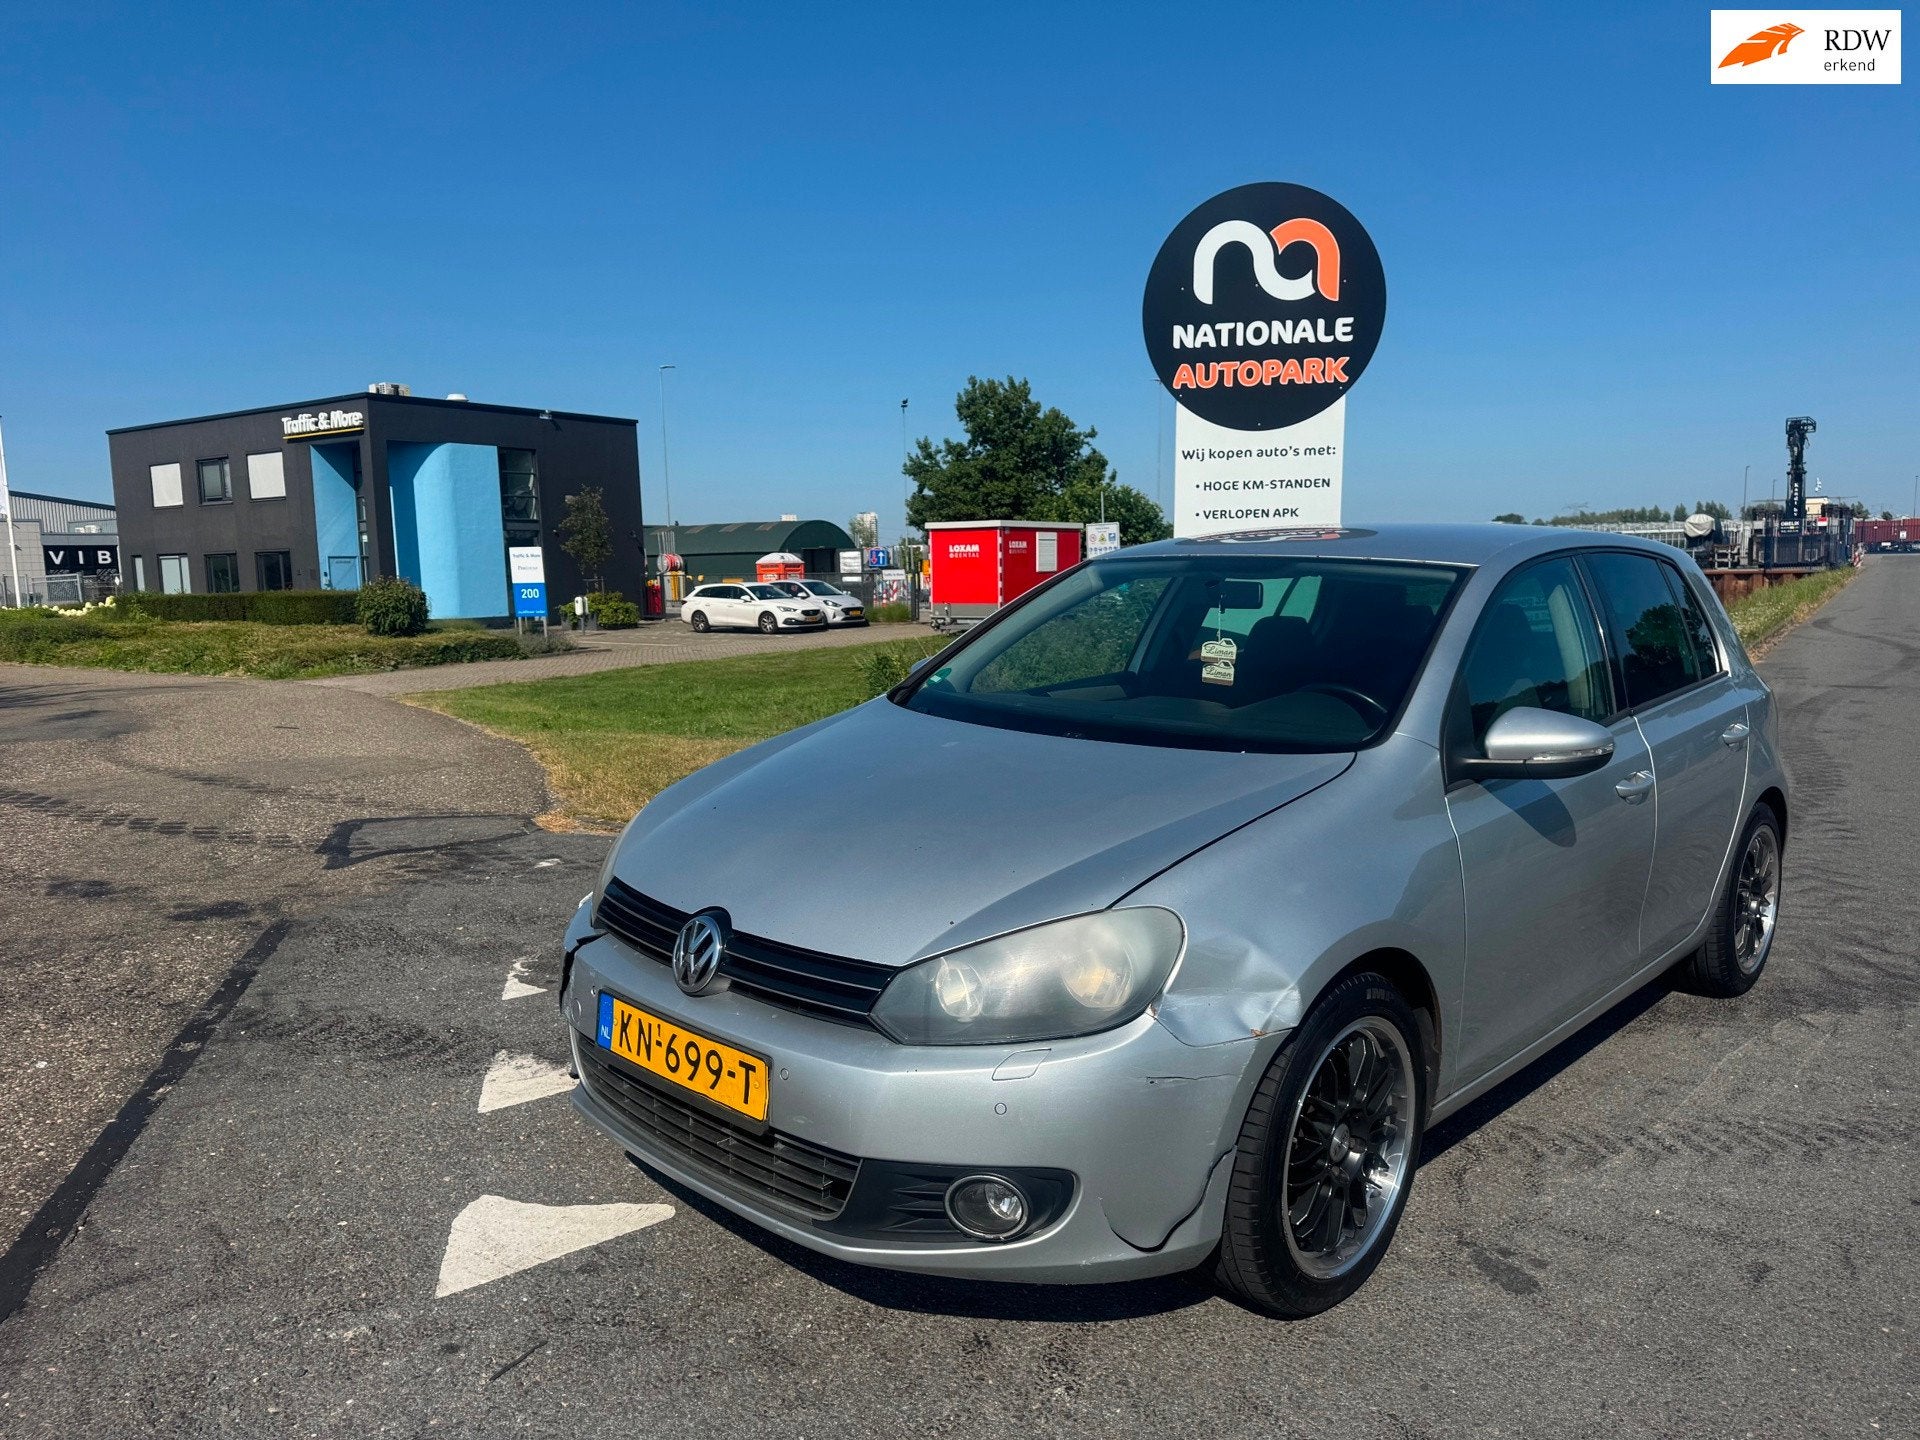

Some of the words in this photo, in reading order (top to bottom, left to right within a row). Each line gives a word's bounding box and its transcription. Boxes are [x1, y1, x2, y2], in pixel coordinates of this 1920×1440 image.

[1172, 316, 1355, 350] NATIONALE
[1172, 356, 1350, 390] AUTOPARK
[281, 413, 319, 435] Traffic
[318, 412, 331, 430] &
[330, 409, 364, 429] More
[1181, 448, 1205, 462] Wij
[1208, 448, 1252, 461] kopen
[1256, 445, 1300, 458] auto's
[1303, 445, 1337, 457] met:
[1203, 480, 1239, 492] HOGE
[1242, 478, 1331, 491] KM-STANDEN
[1203, 508, 1270, 520] VERLOPEN
[1272, 507, 1300, 518] APK
[948, 544, 980, 553] LOXAM
[48, 550, 112, 565] VIB
[520, 588, 540, 599] 200
[600, 1024, 611, 1040] NL
[618, 1009, 757, 1105] KN-699-T
